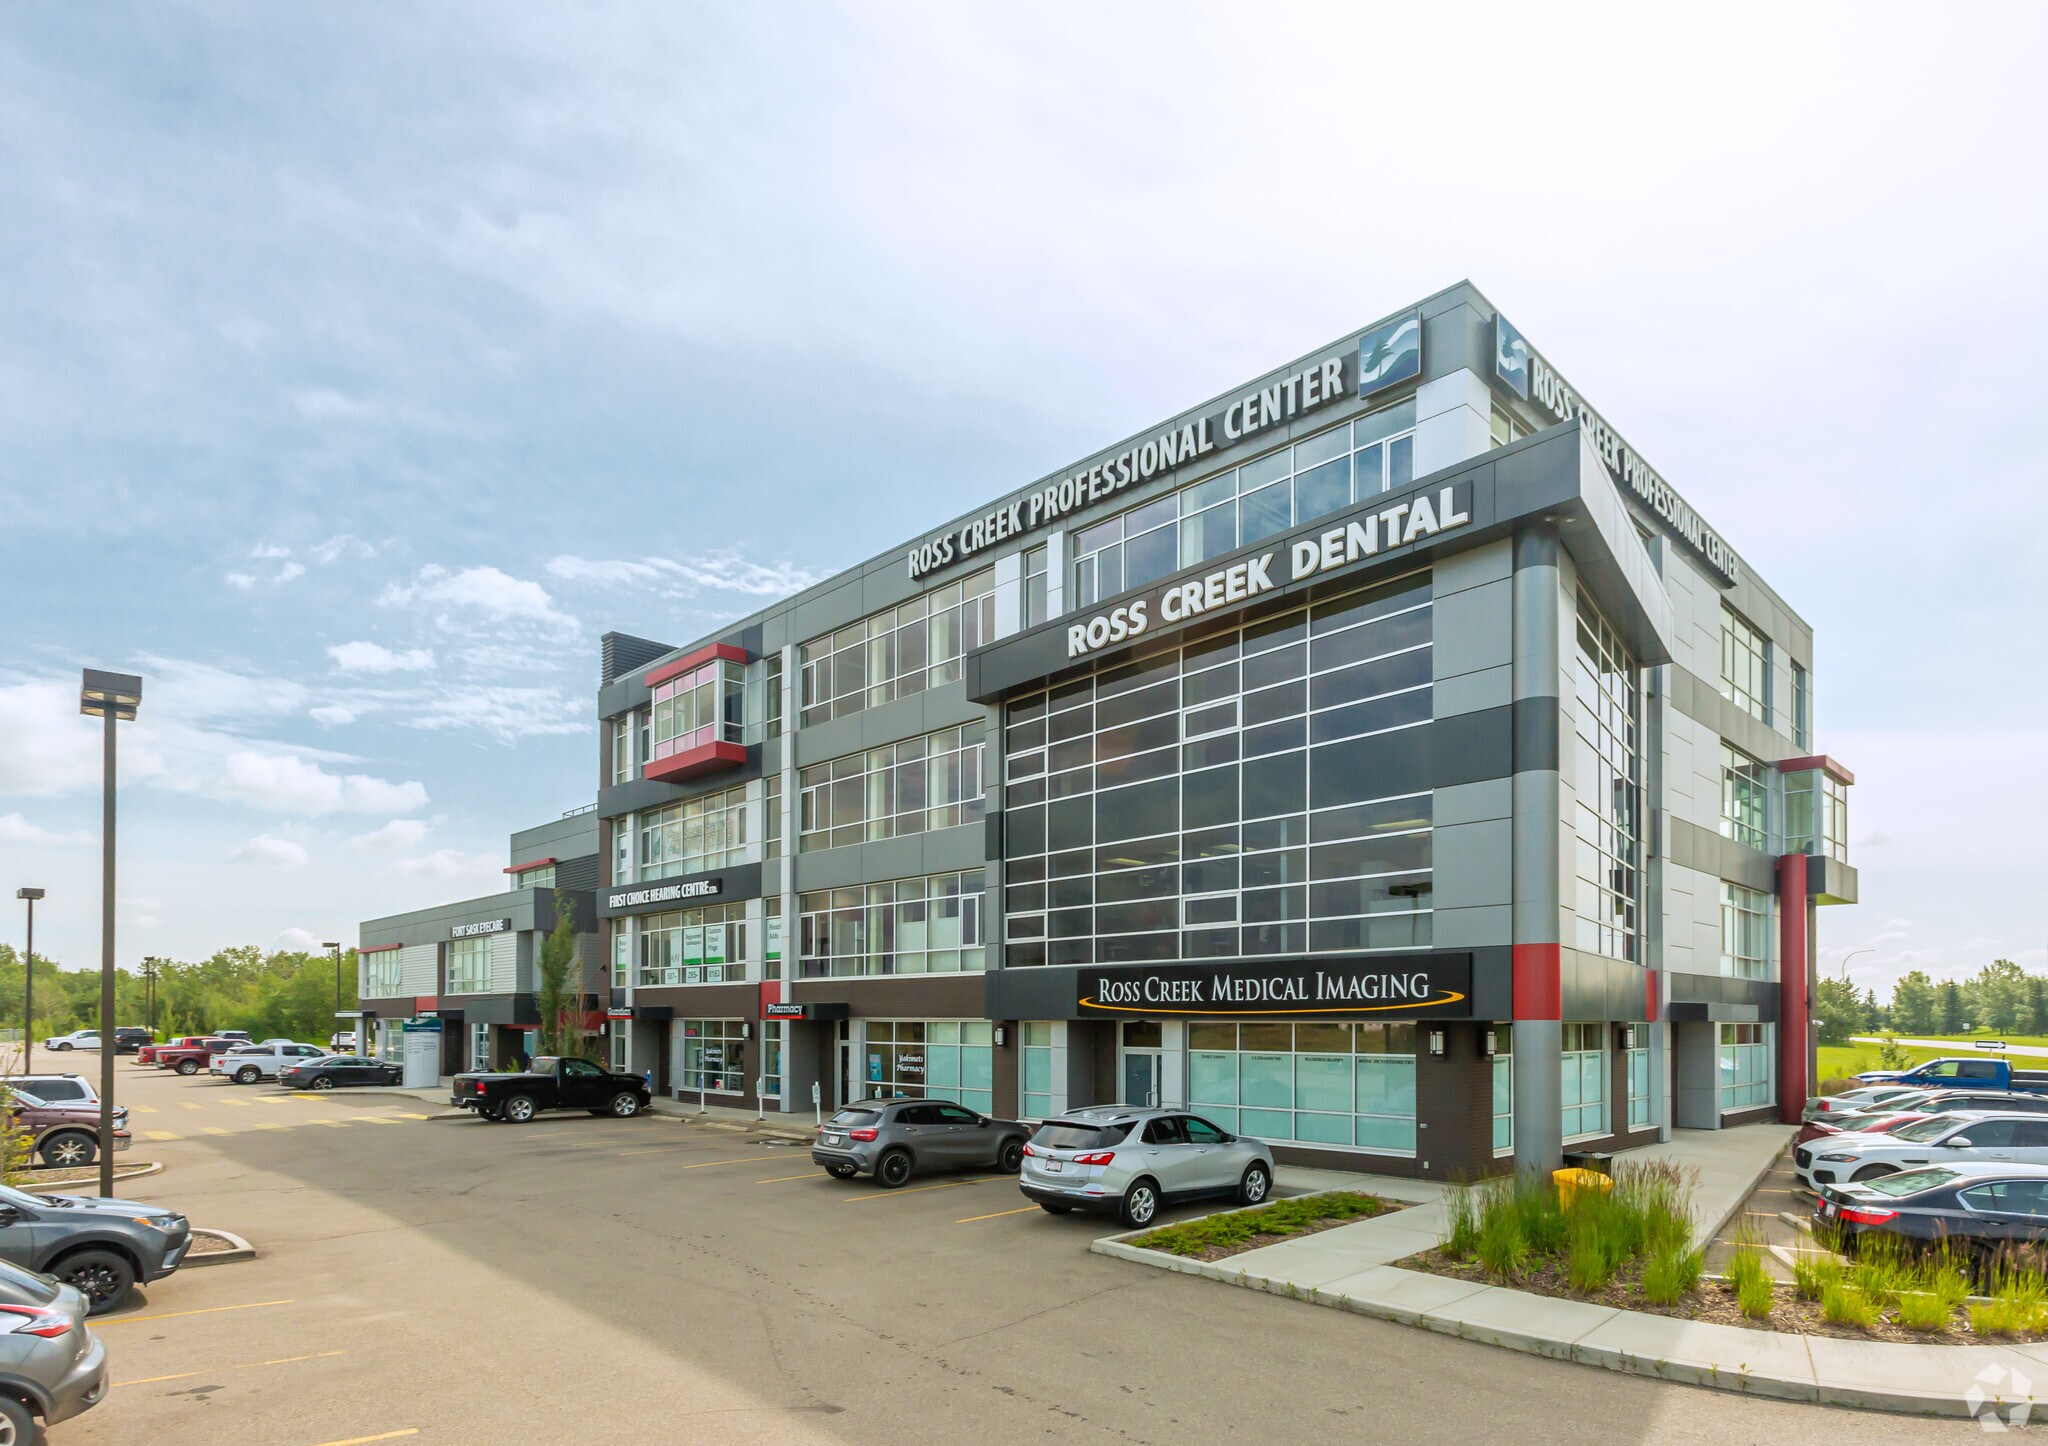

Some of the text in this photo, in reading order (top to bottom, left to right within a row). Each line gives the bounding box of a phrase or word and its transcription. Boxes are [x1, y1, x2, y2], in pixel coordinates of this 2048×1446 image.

[908, 356, 1344, 579] ROSS CREEK PROFESSIONAL CENTER
[1532, 356, 1573, 422] ROSS
[1623, 448, 1705, 553] PROFESSIONAL
[1705, 530, 1740, 585] CENTER
[1067, 487, 1471, 658] ROSS CREEK DENTAL
[609, 893, 627, 908] FIRST
[627, 890, 650, 906] CHOICE
[650, 885, 681, 903] HEARING
[681, 880, 709, 898] CENTRE
[452, 919, 504, 938] FORT SASK EYECARE
[768, 1004, 803, 1016] Pharmacy
[896, 1064, 925, 1074] Pharmacy
[898, 1054, 923, 1063] Yakimets
